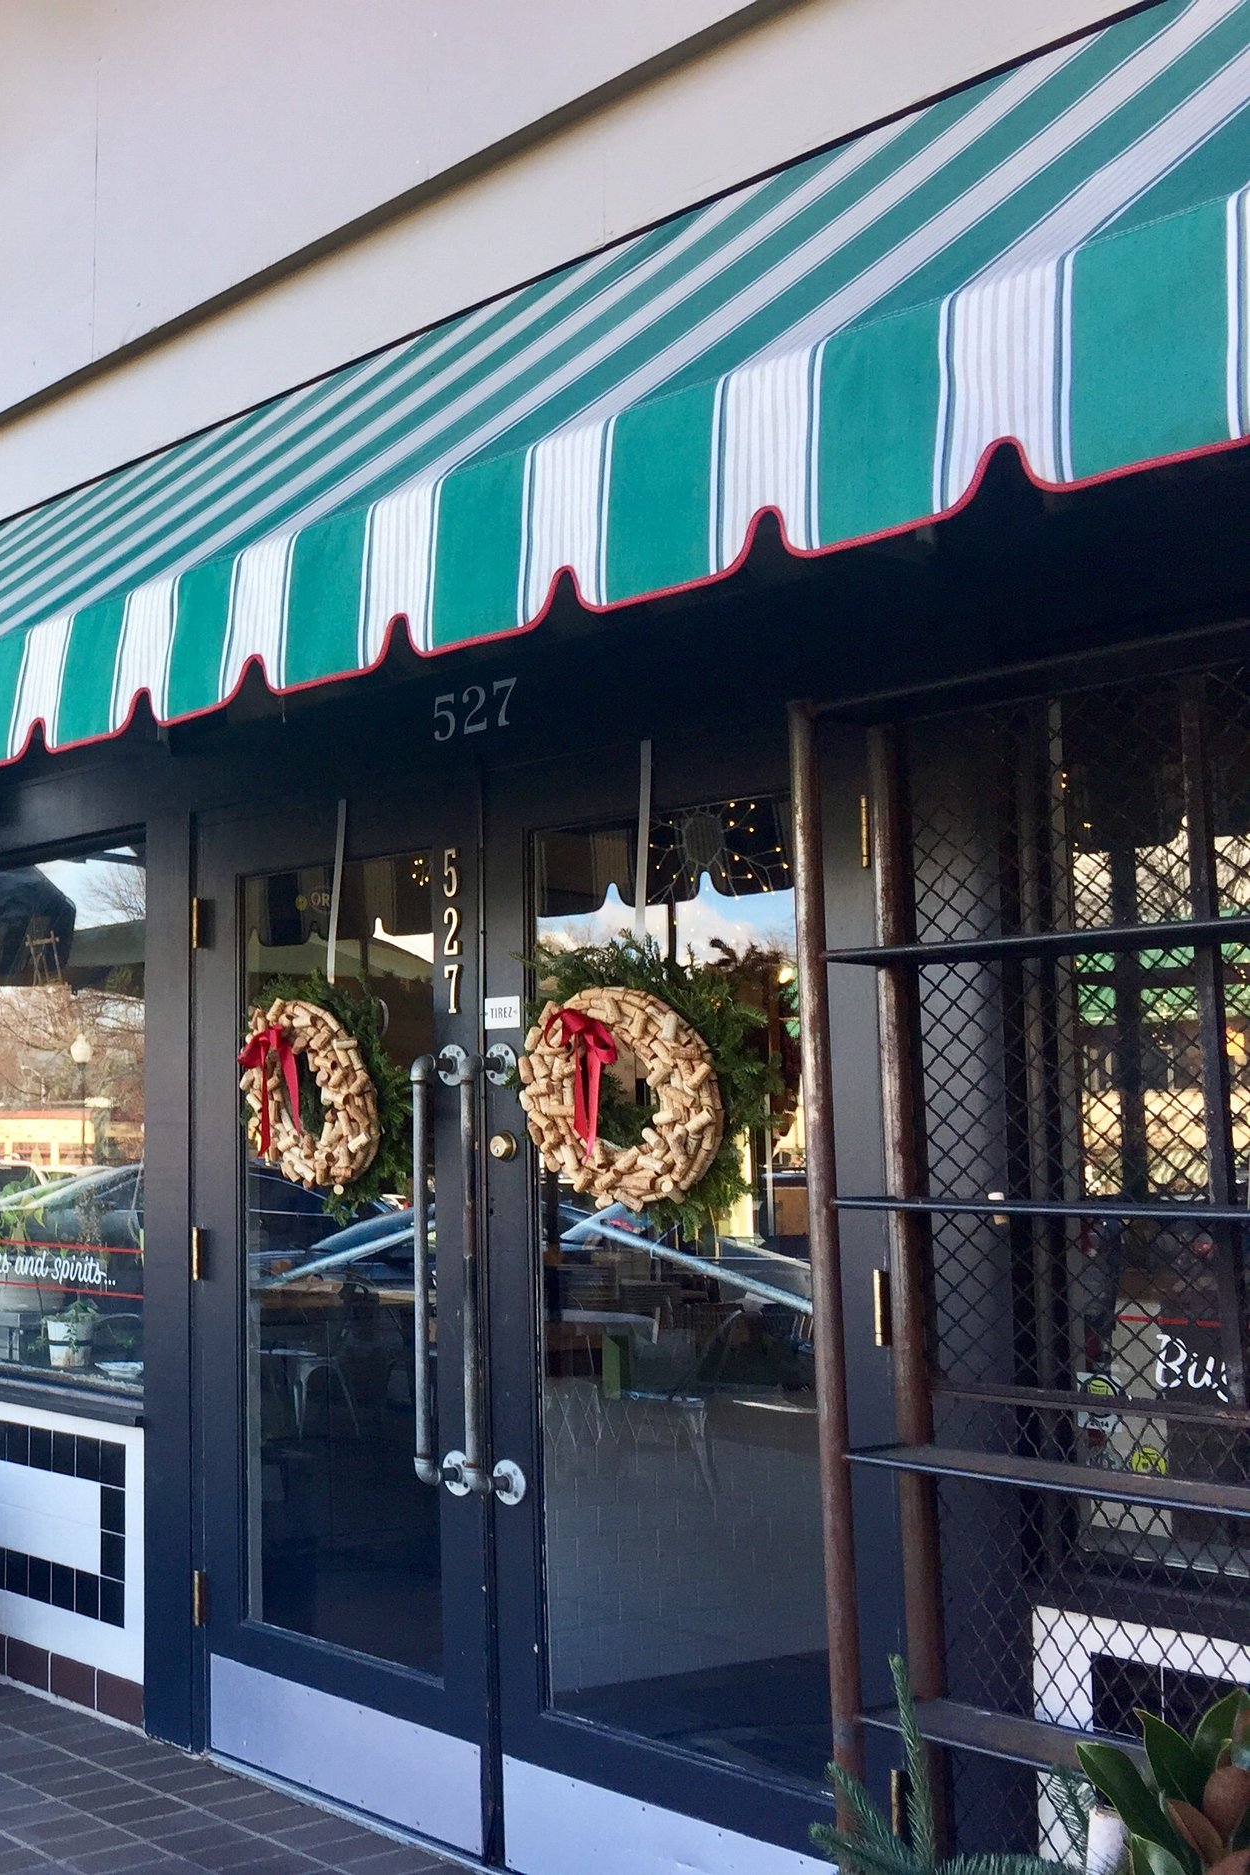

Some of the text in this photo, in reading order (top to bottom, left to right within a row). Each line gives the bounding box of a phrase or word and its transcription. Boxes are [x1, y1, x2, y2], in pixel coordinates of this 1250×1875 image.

[432, 676, 517, 742] 527
[442, 847, 460, 1015] 527
[490, 1006, 513, 1019] TIREZ
[14, 1251, 49, 1278] and
